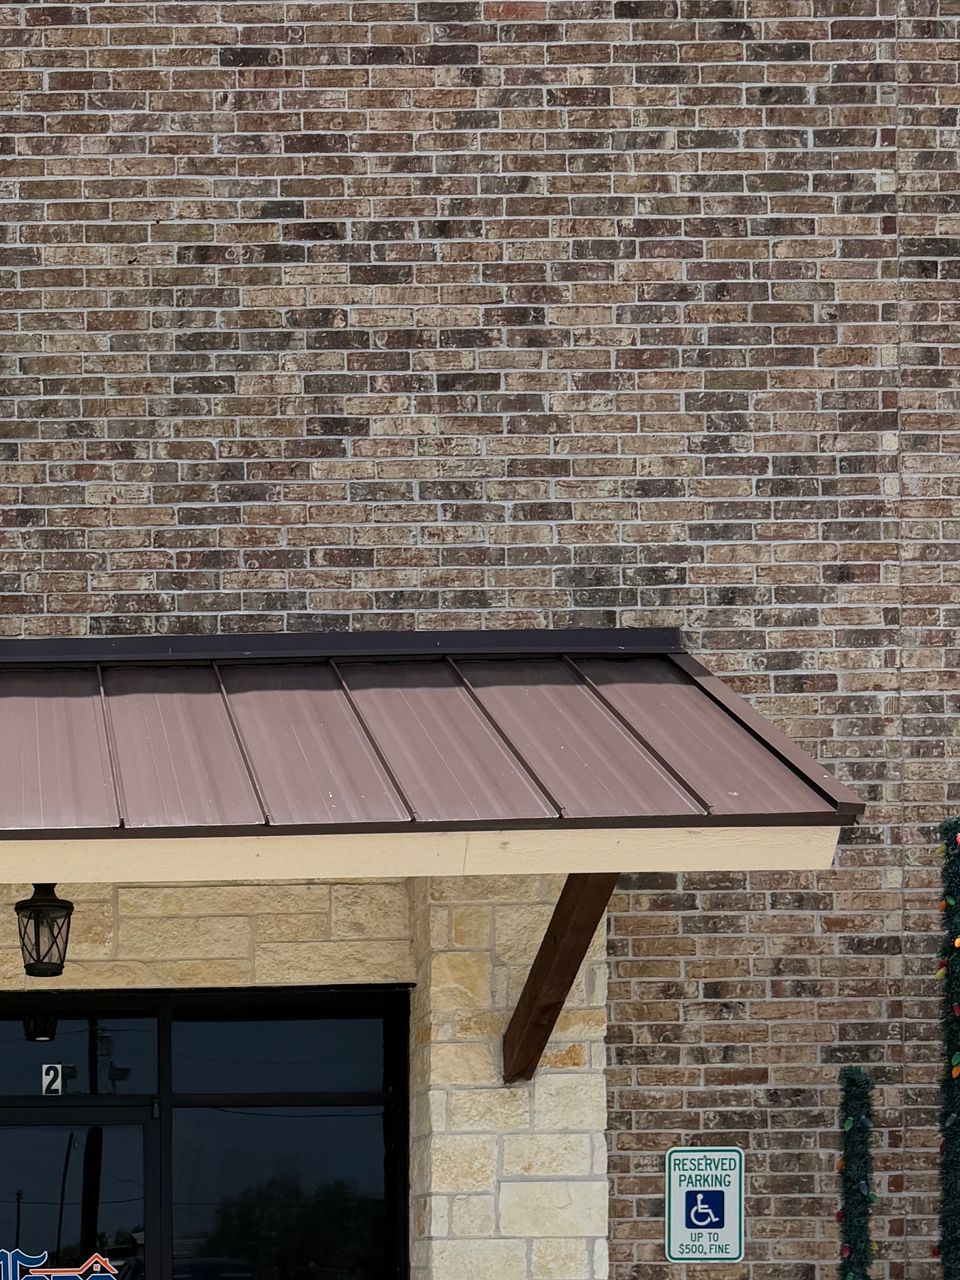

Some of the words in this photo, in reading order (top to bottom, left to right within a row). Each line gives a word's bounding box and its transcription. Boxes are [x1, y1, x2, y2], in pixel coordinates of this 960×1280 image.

[44, 1065, 60, 1095] 2
[673, 1157, 737, 1172] RESERVED
[678, 1174, 732, 1188] PARKING
[690, 1232, 703, 1242] UP
[708, 1232, 719, 1242] TO
[709, 1243, 730, 1254] FINE
